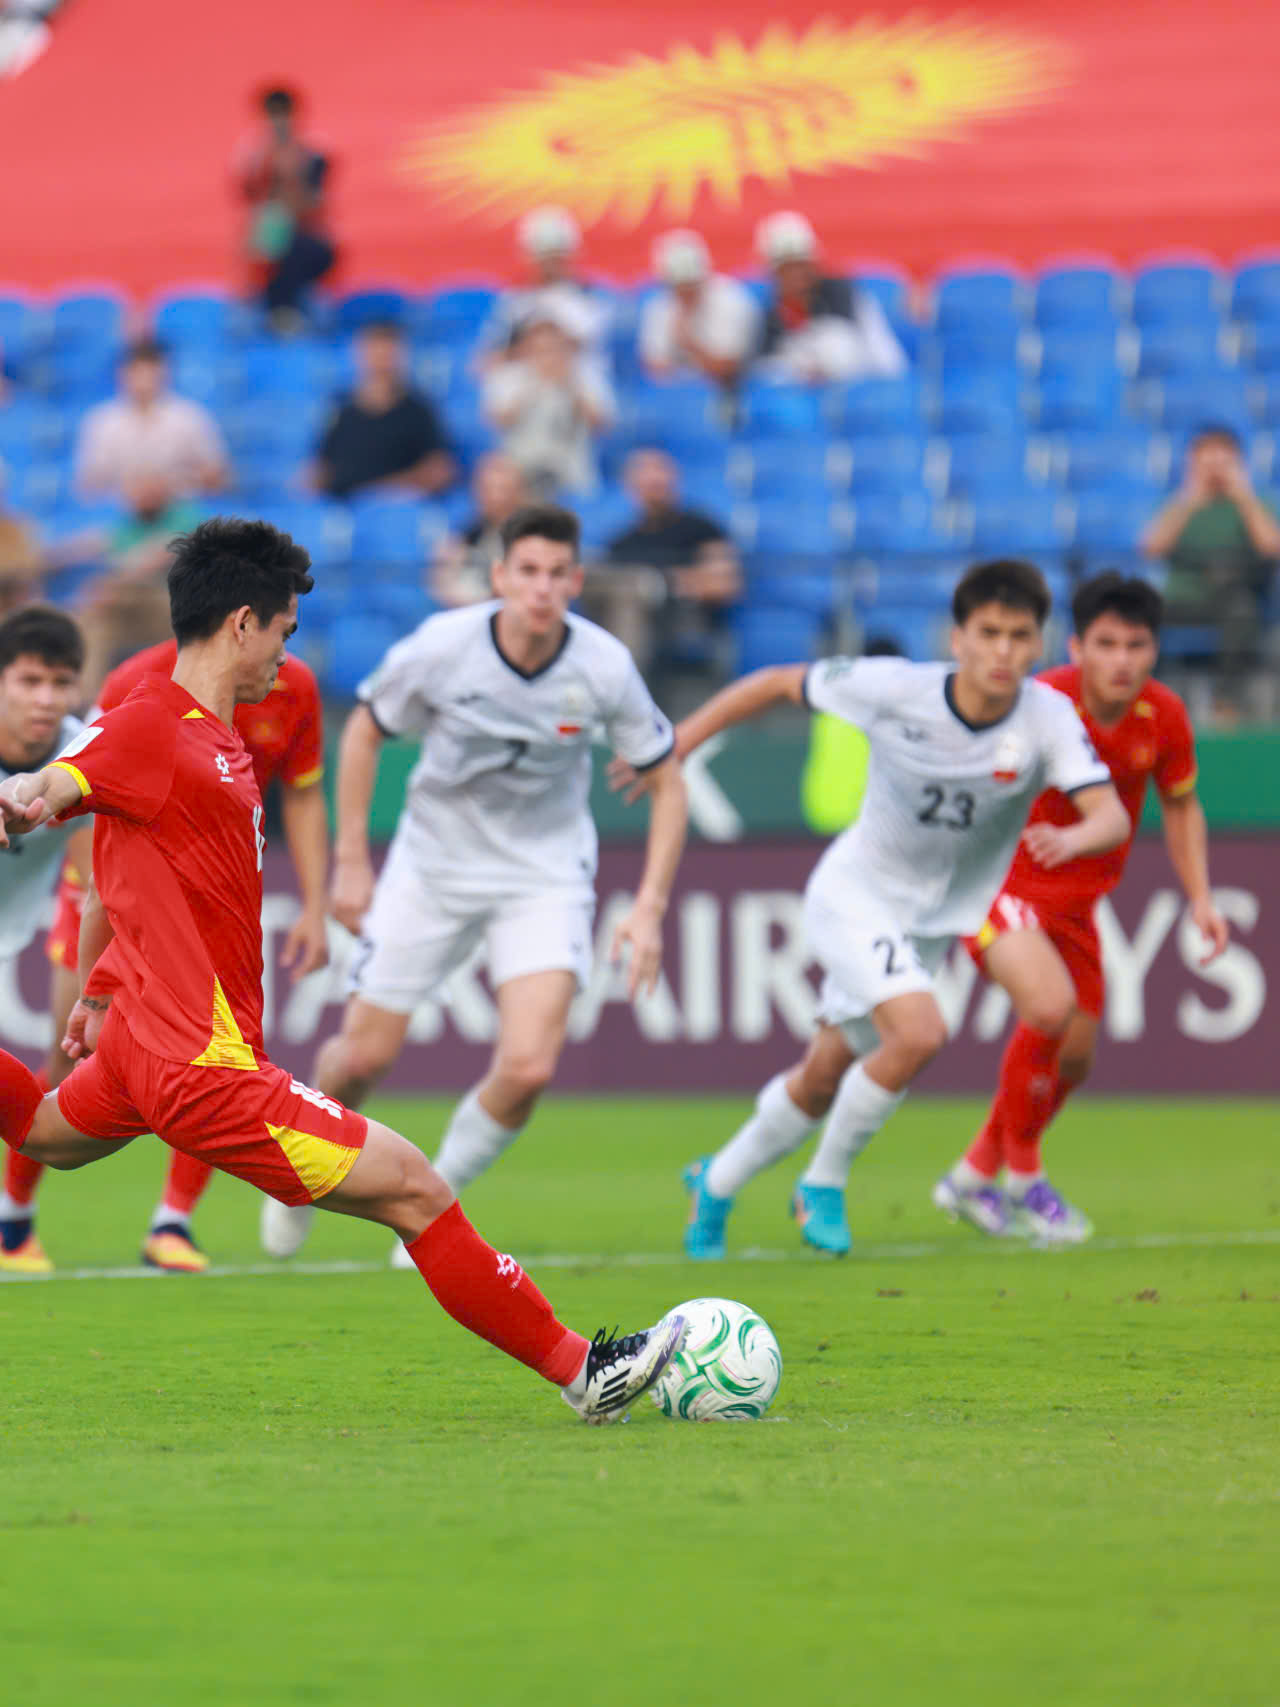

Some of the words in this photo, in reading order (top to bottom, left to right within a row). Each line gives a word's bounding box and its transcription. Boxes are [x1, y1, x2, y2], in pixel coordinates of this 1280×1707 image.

[918, 784, 975, 831] 23
[567, 886, 1268, 1044] AIRYS
[873, 934, 912, 976] 2
